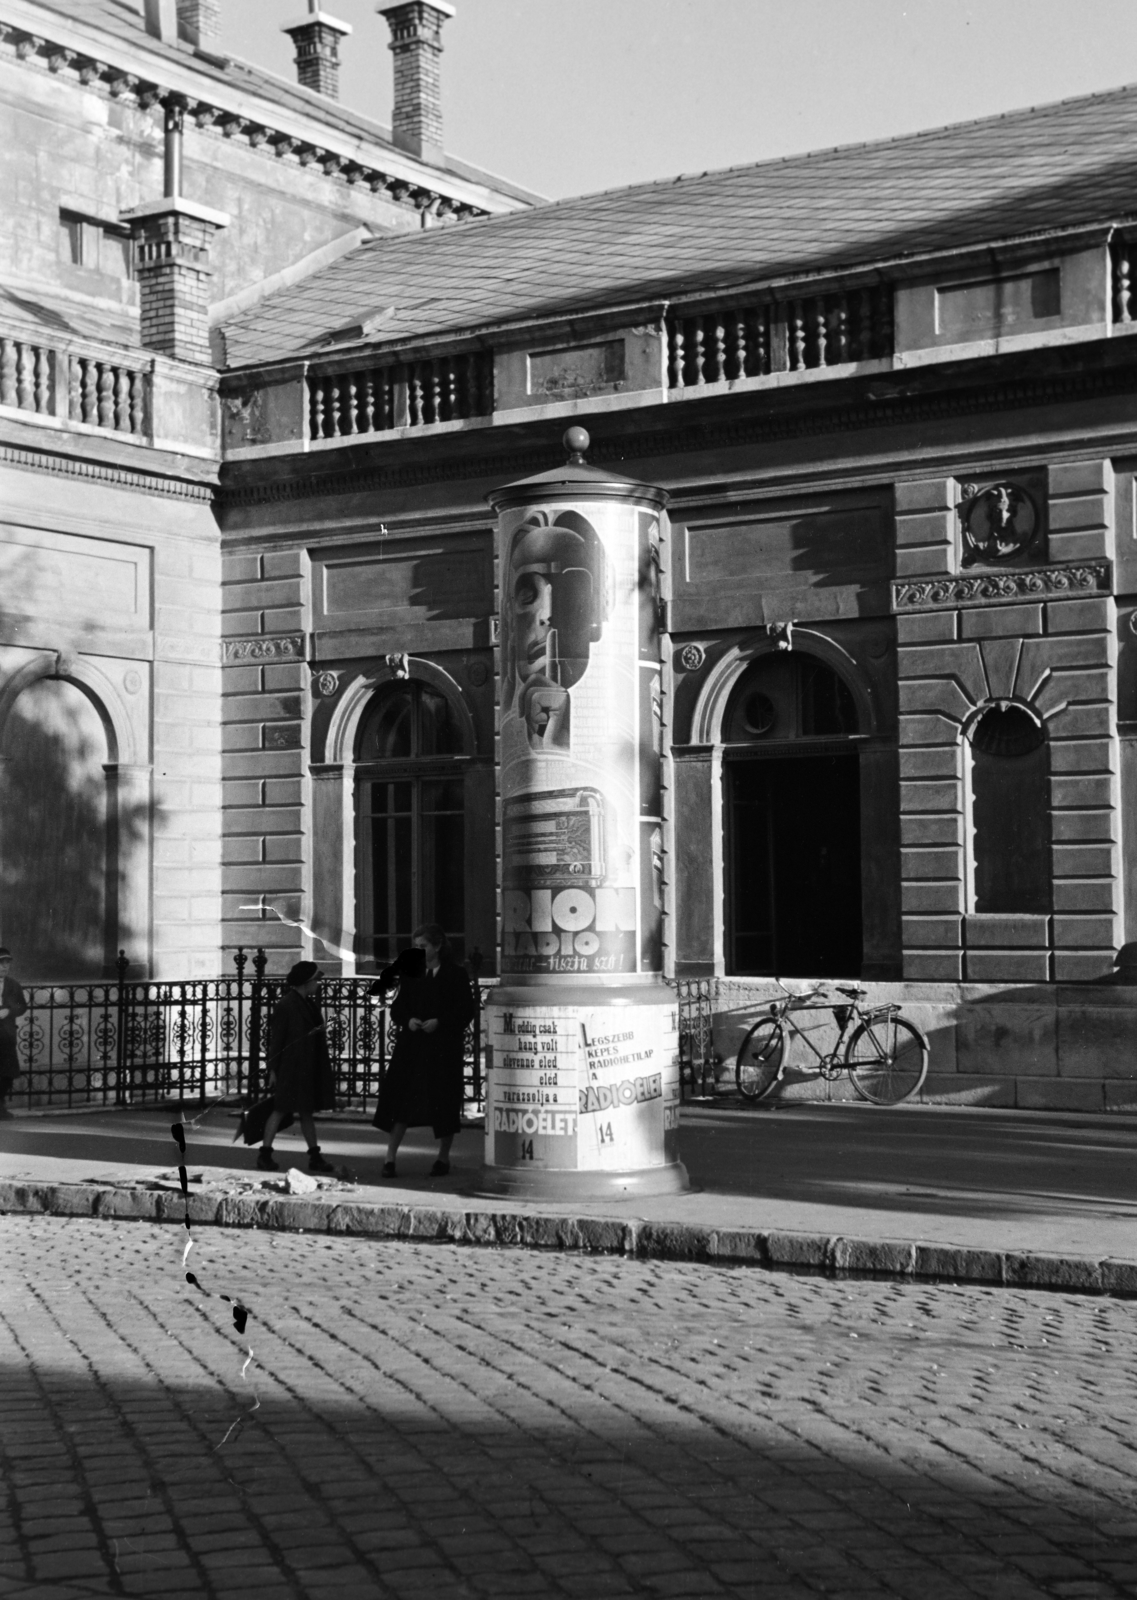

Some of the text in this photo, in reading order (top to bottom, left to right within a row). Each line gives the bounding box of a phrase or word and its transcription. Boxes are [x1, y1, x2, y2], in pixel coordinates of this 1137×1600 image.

[501, 888, 637, 932] RION
[548, 955, 589, 971] tiszta
[503, 1012, 558, 1038] Mi eddig csak
[580, 1022, 635, 1048] LEGSZEBB
[518, 1037, 558, 1056] hang volt
[591, 1072, 599, 1081] A
[551, 1093, 558, 1103] a
[599, 1121, 615, 1144] 14
[520, 1139, 535, 1161] 14
